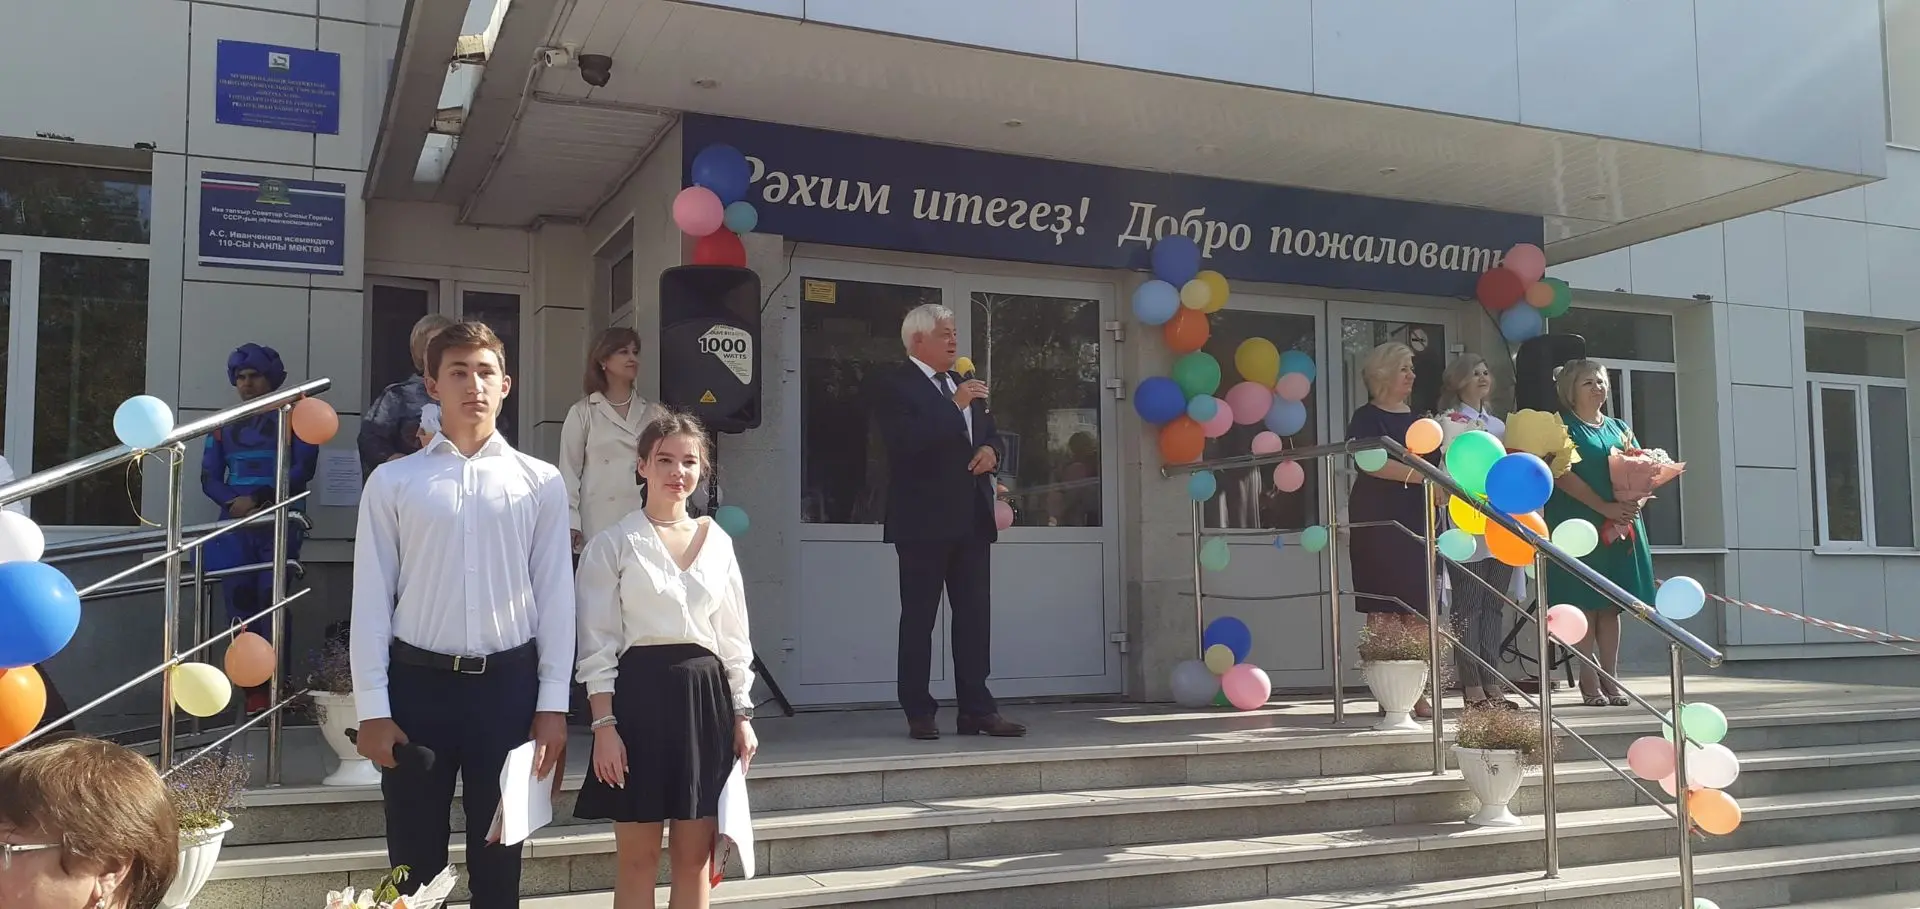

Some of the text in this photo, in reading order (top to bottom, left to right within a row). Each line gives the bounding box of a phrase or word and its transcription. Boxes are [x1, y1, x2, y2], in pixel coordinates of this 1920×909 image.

[912, 188, 1090, 245] итегеҙ!
[1117, 201, 1252, 259] Добро
[229, 230, 283, 242] Иванченков
[699, 337, 747, 353] 1000
